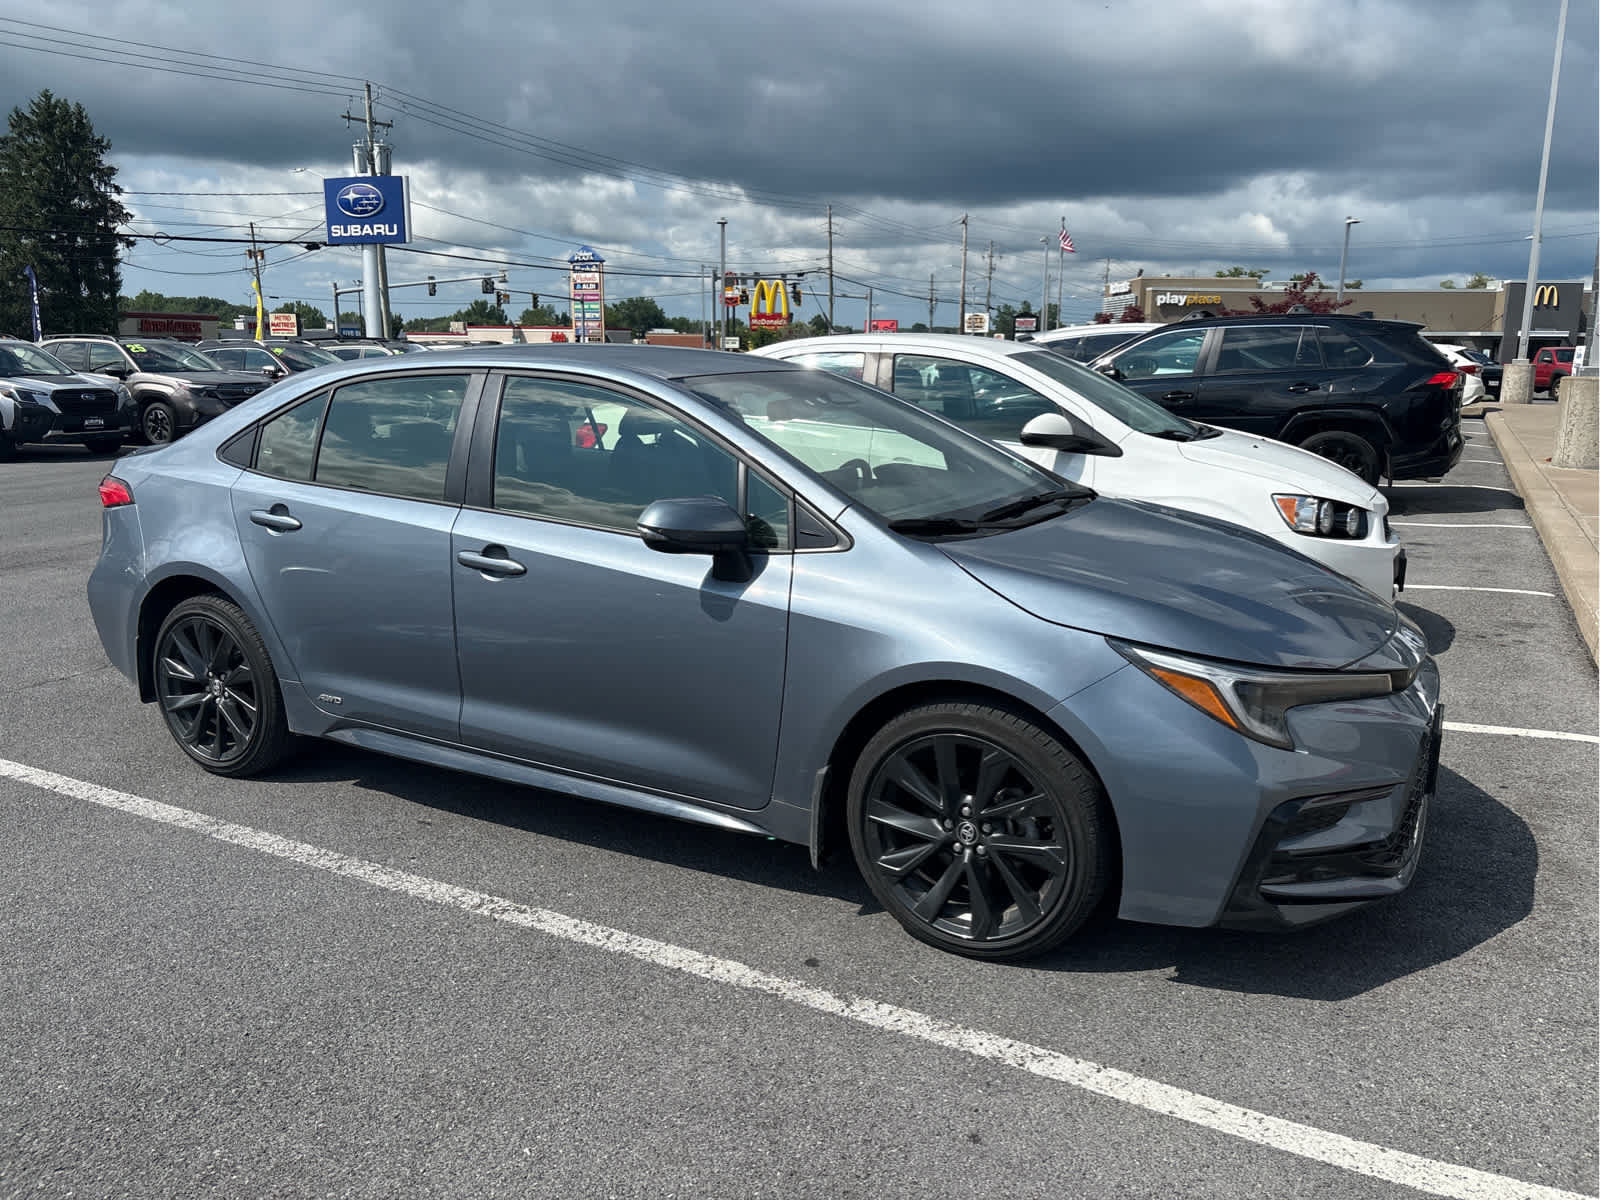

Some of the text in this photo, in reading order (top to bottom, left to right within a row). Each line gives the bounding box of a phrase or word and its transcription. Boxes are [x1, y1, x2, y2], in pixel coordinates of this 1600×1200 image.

[331, 224, 398, 237] SUBARU
[1156, 292, 1222, 306] playplace
[126, 343, 147, 353] 25
[318, 693, 342, 704] AWD
